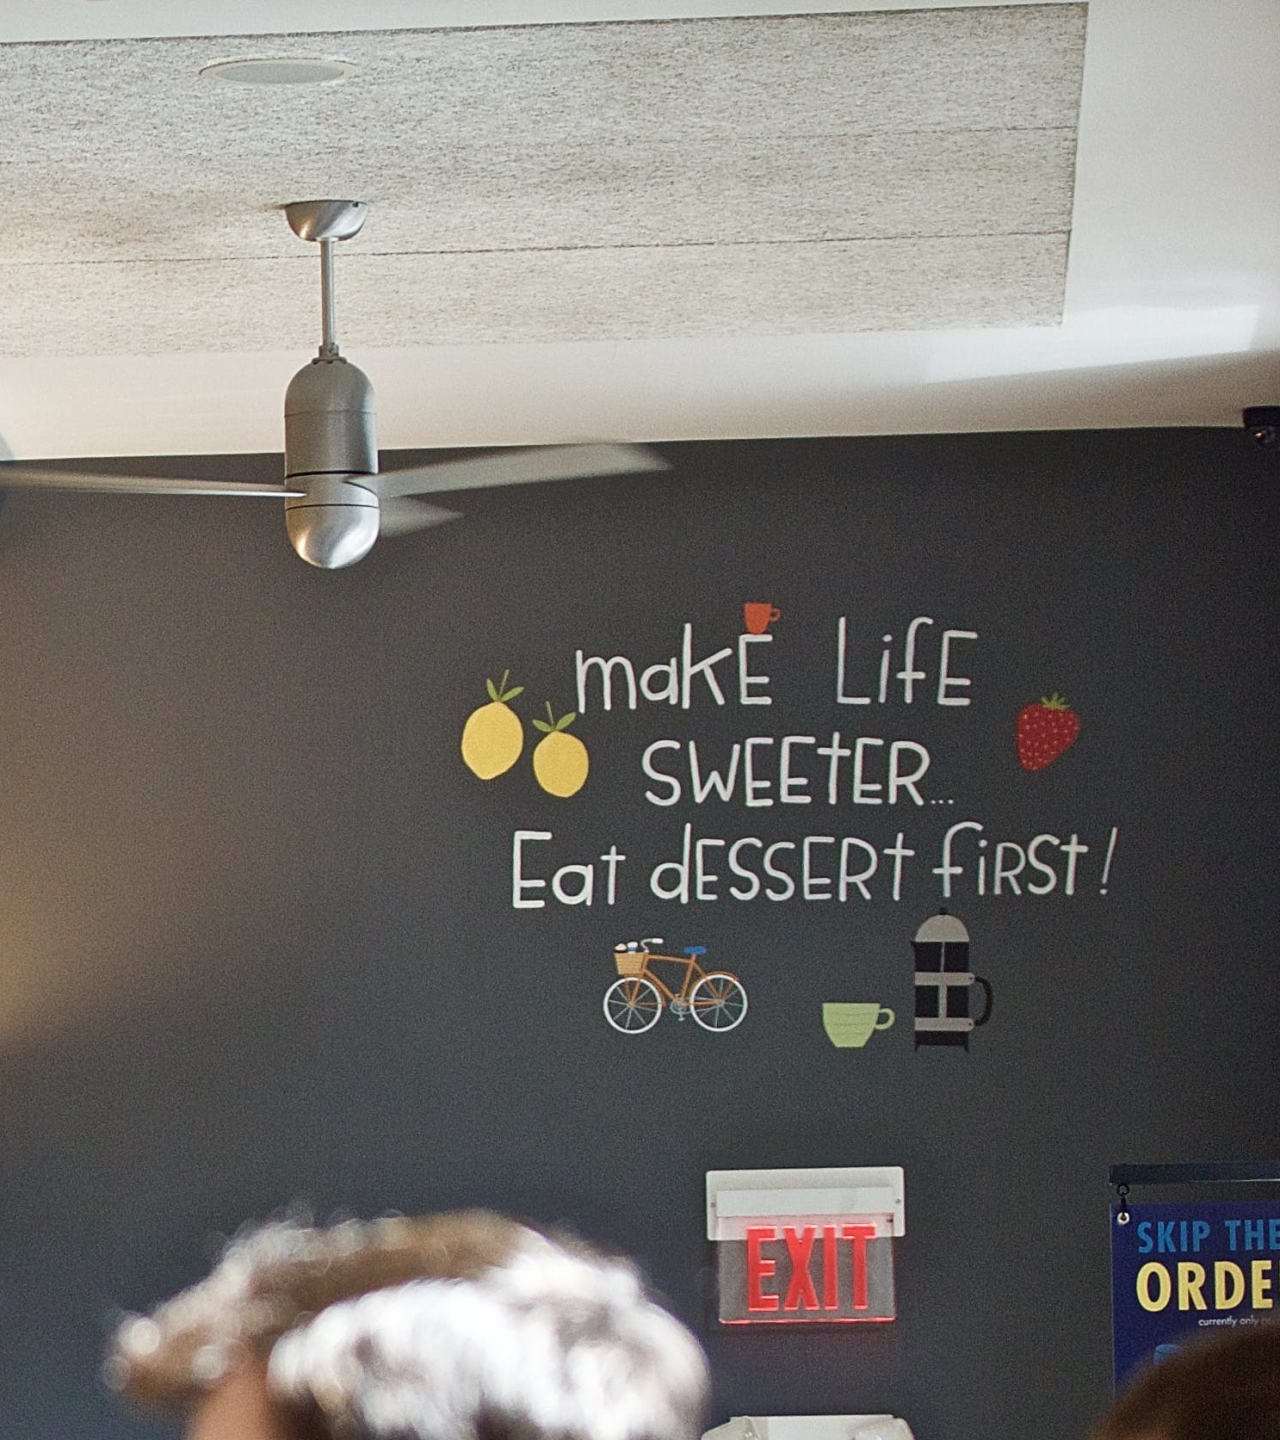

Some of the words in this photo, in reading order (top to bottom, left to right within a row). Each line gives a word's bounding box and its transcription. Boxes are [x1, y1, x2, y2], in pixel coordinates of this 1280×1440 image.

[512, 830, 626, 908] Eat
[1136, 1220, 1211, 1254] SKIP
[1224, 1218, 1280, 1252] THE
[746, 1222, 877, 1313] EXIT
[1135, 1260, 1278, 1313] ORDE
[1198, 1315, 1238, 1328] currently
